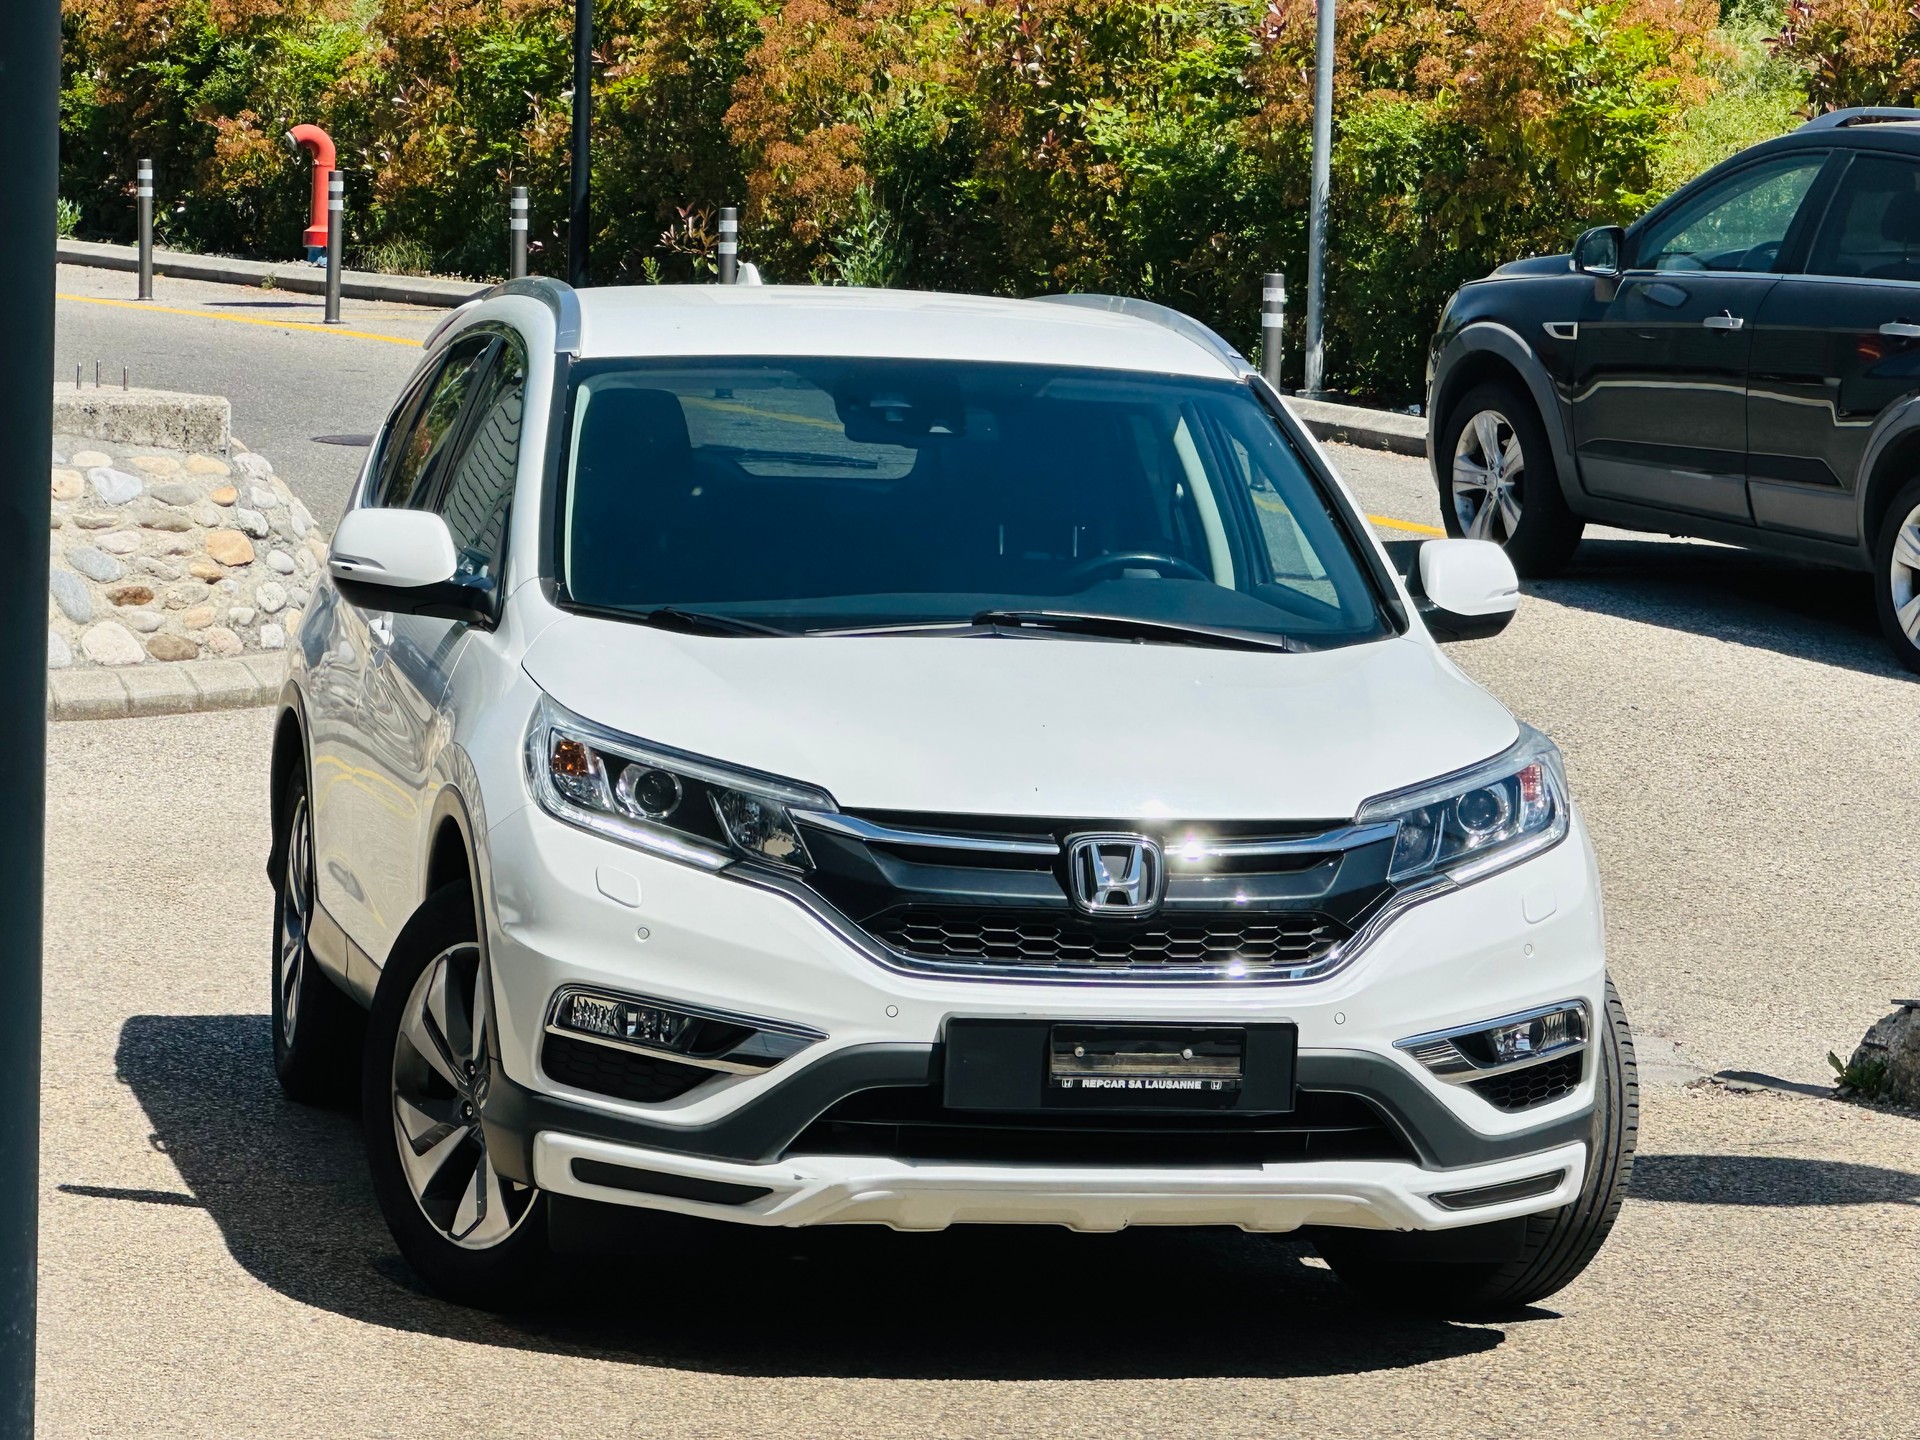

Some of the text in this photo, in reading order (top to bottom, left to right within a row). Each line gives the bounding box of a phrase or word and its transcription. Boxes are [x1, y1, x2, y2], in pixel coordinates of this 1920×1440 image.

[1081, 1079, 1126, 1089] REPCAR
[1127, 1079, 1143, 1089] SA
[1145, 1079, 1202, 1090] LAUSANNE
